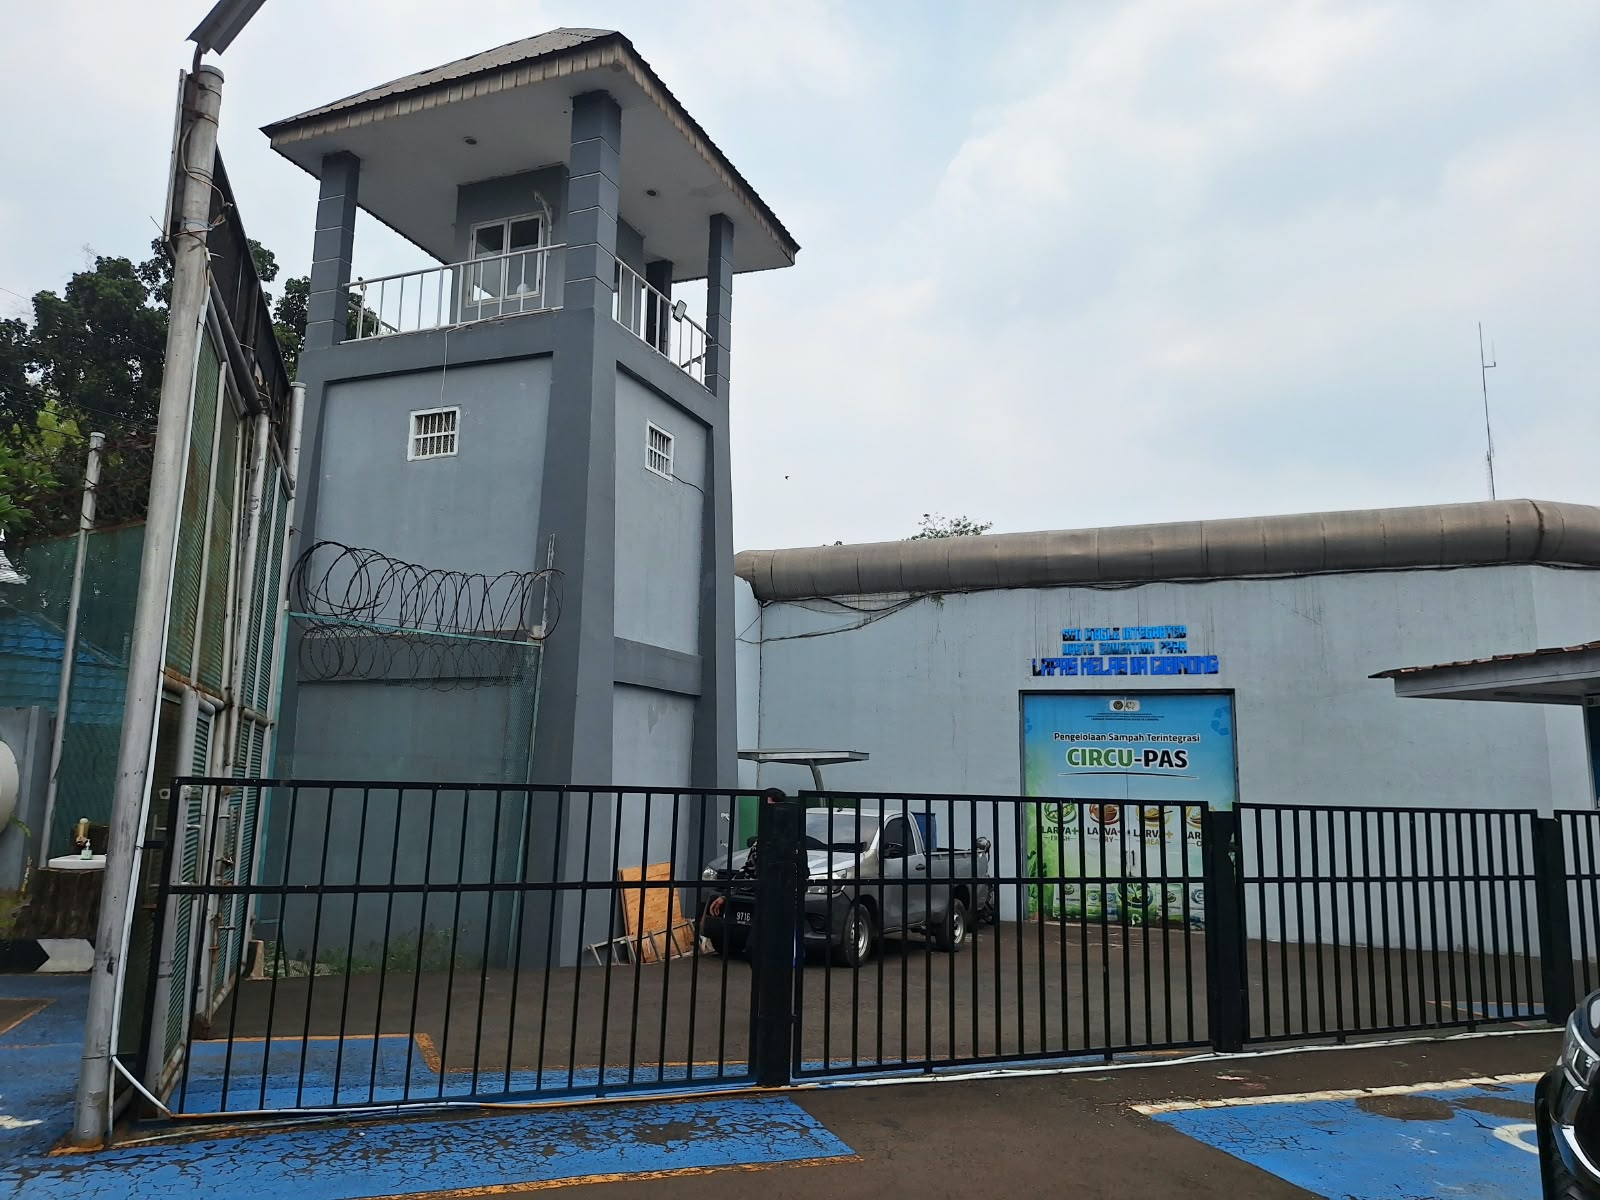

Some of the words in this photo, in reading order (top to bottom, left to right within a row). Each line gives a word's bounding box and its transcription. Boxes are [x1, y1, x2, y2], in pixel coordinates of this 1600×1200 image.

[1032, 657, 1078, 676] LAPAS
[1081, 656, 1128, 675] KELAS
[1150, 655, 1219, 675] CIBINONG
[1054, 732, 1106, 742] Pengelolaan
[1108, 733, 1144, 743] Sampah
[1147, 733, 1200, 744] Terintegrasi
[1067, 748, 1188, 768] CIRCU-PAS
